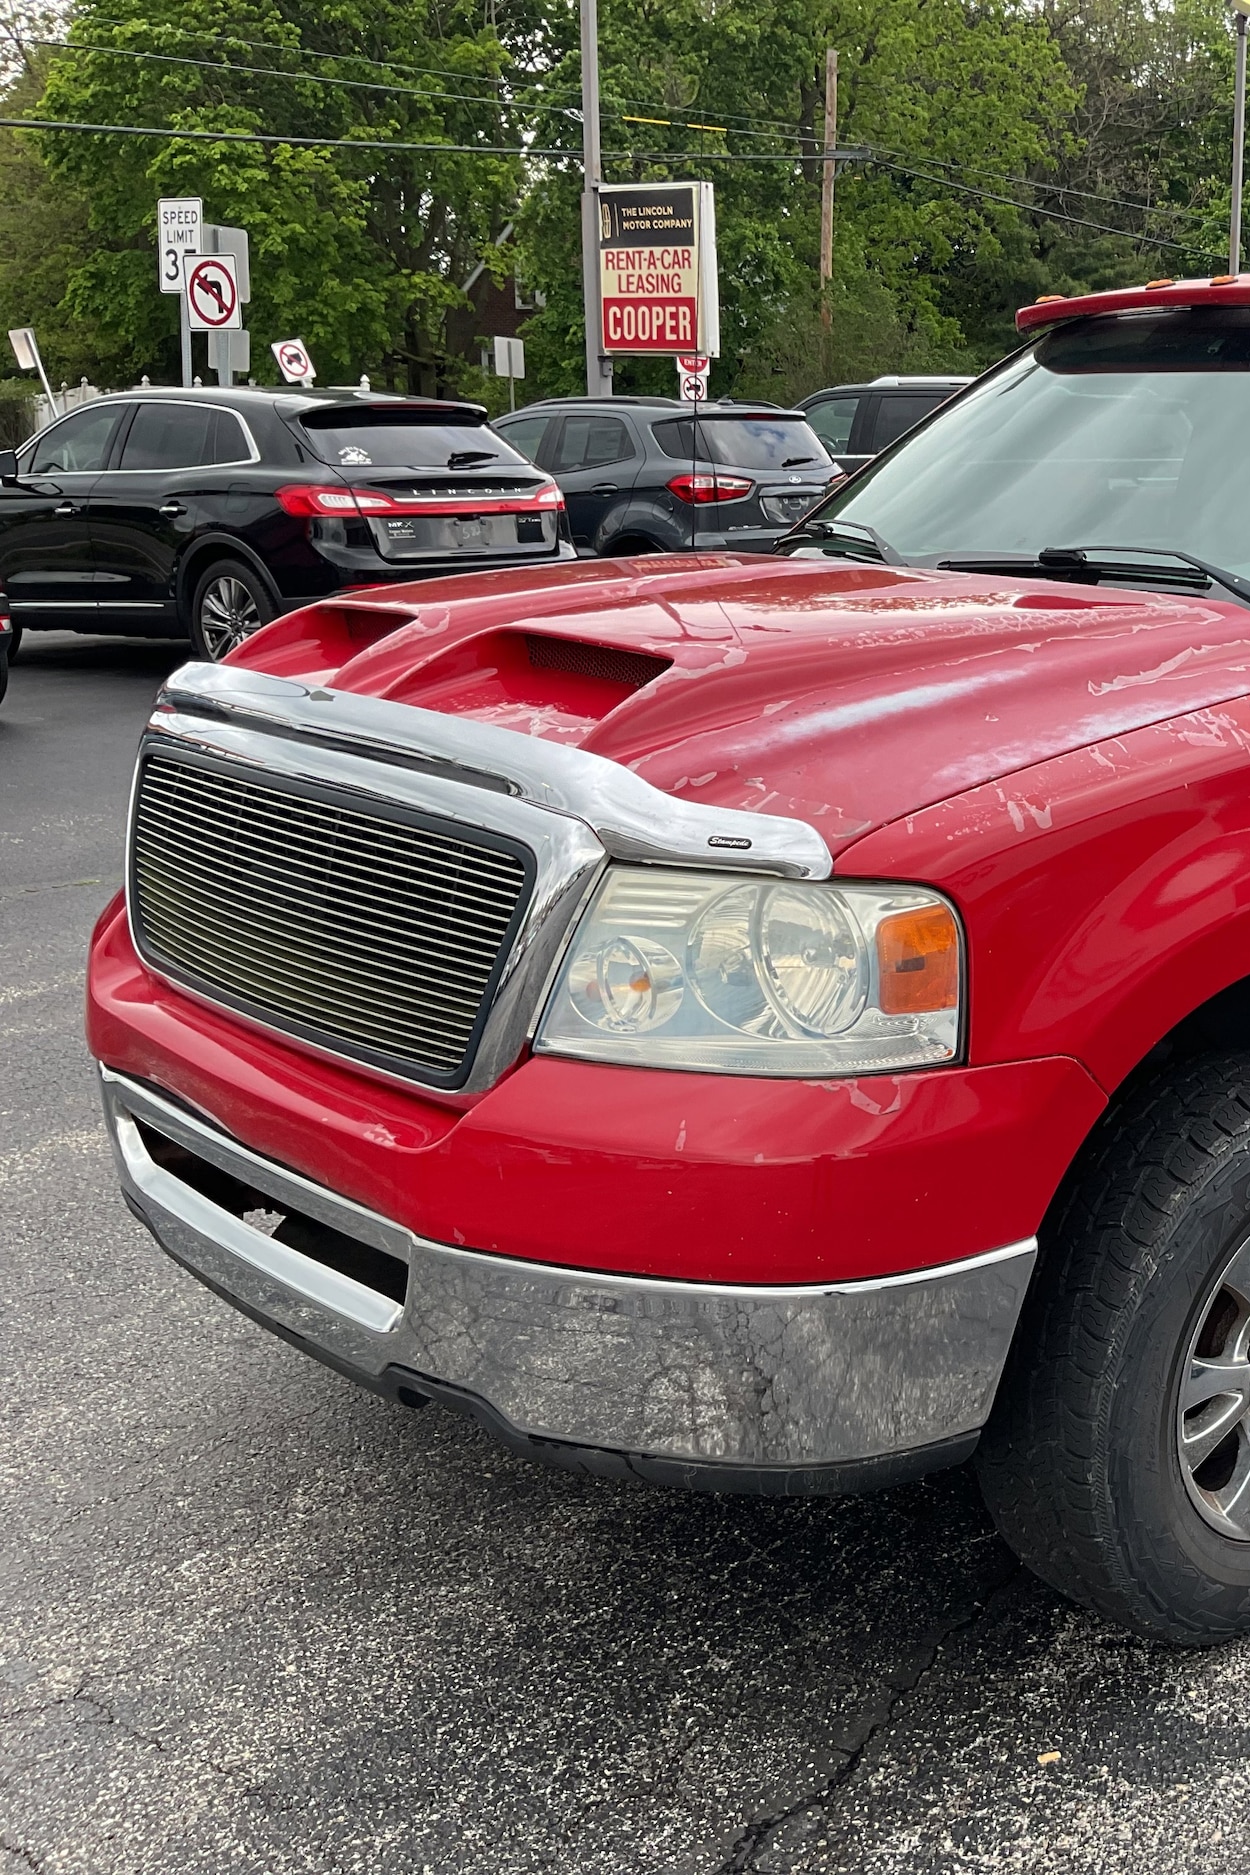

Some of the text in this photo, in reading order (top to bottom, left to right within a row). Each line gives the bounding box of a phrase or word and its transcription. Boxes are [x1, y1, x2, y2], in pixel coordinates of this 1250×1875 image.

[163, 210, 198, 225] SPEED
[621, 206, 673, 217] THE LINCOLN
[622, 218, 692, 230] MOTOR COMPANY
[166, 229, 194, 244] LIMIT
[605, 248, 692, 270] RENT-A-CAR
[618, 273, 682, 294] LEASING
[608, 305, 692, 341] COOPER
[412, 487, 521, 496] LINCOLN
[709, 837, 749, 847] Stampede
